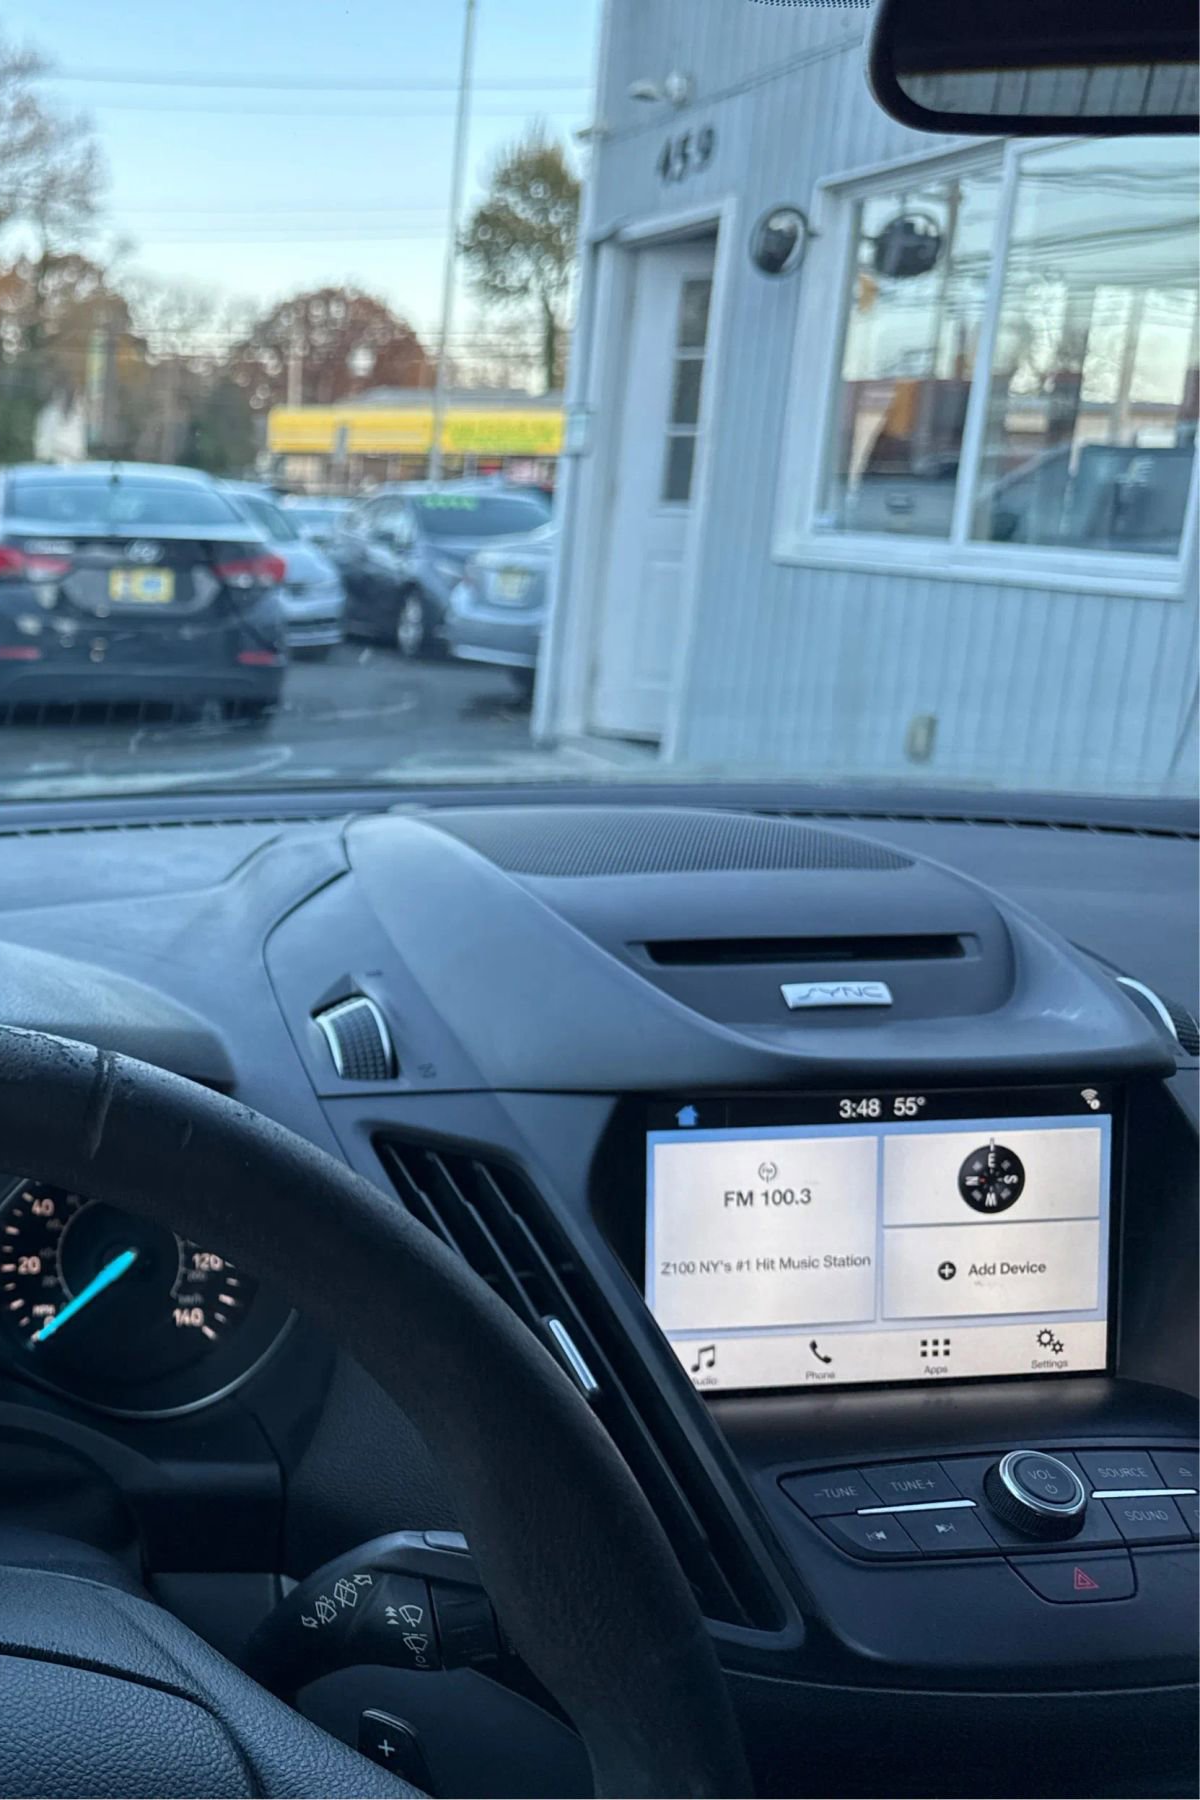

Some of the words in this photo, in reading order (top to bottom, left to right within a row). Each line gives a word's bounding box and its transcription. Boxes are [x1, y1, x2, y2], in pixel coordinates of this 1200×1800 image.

[797, 986, 885, 1000] SYNC
[839, 1099, 882, 1118] 3:48
[893, 1096, 926, 1116] 55°
[723, 1190, 754, 1208] FM
[761, 1188, 812, 1206] 100.3
[32, 1198, 55, 1216] 40
[18, 1256, 42, 1275] 20
[192, 1252, 224, 1271] 120
[661, 1262, 695, 1275] Z100
[699, 1260, 732, 1274] NY's
[736, 1261, 751, 1273] #1
[756, 1258, 776, 1271] Hit
[779, 1256, 819, 1270] Music
[823, 1254, 872, 1268] Station
[968, 1263, 996, 1277] Add
[1000, 1261, 1047, 1275] Device
[173, 1307, 204, 1327] 140
[923, 1364, 949, 1376] Apps
[1031, 1360, 1069, 1371] Settings
[805, 1370, 836, 1381] Phone
[1027, 1467, 1057, 1481] VOL
[1097, 1467, 1149, 1480] SOURCE
[1124, 1509, 1170, 1522] SOUND
